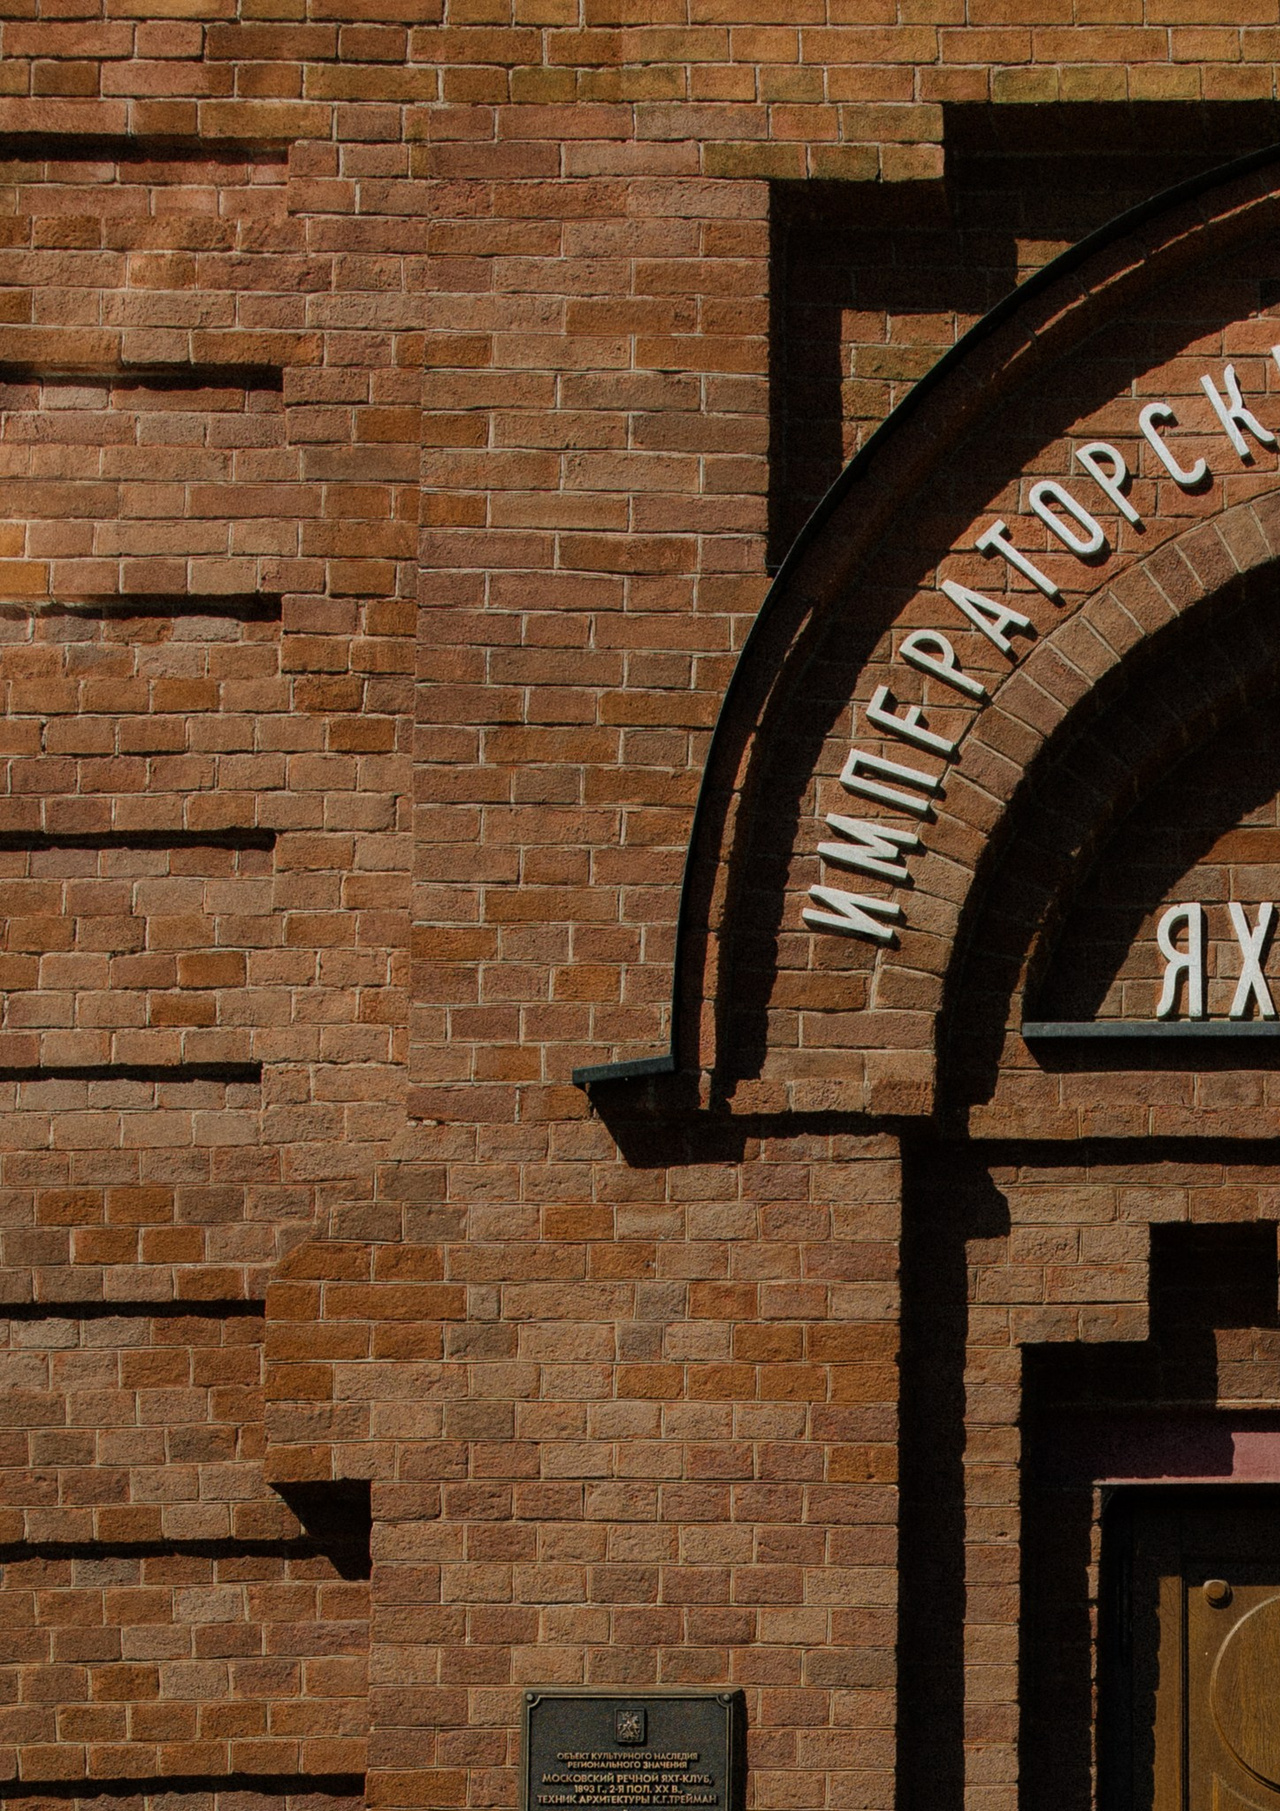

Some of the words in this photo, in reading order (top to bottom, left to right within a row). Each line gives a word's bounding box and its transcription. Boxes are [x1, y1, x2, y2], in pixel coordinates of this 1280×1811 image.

[556, 1752, 590, 1761] ОБЪЕКТ
[591, 1752, 652, 1761] КУЛЬТУРНОГО
[654, 1752, 698, 1761] НАСЛЕДИЯ
[567, 1761, 640, 1769] РЕГИОНАЛЬНОГО
[643, 1761, 687, 1769] ЗНАЧЕНИЯ
[542, 1773, 614, 1783] МОСКОВСКИЙ
[617, 1773, 659, 1783] РЕЧНОЙ
[574, 1785, 595, 1794] 1893
[609, 1785, 624, 1794] 2-Я
[626, 1785, 651, 1794] ПОЛ.
[537, 1795, 577, 1804] ТЕХНИК
[579, 1795, 650, 1804] АРХИТЕКТУРЫ
